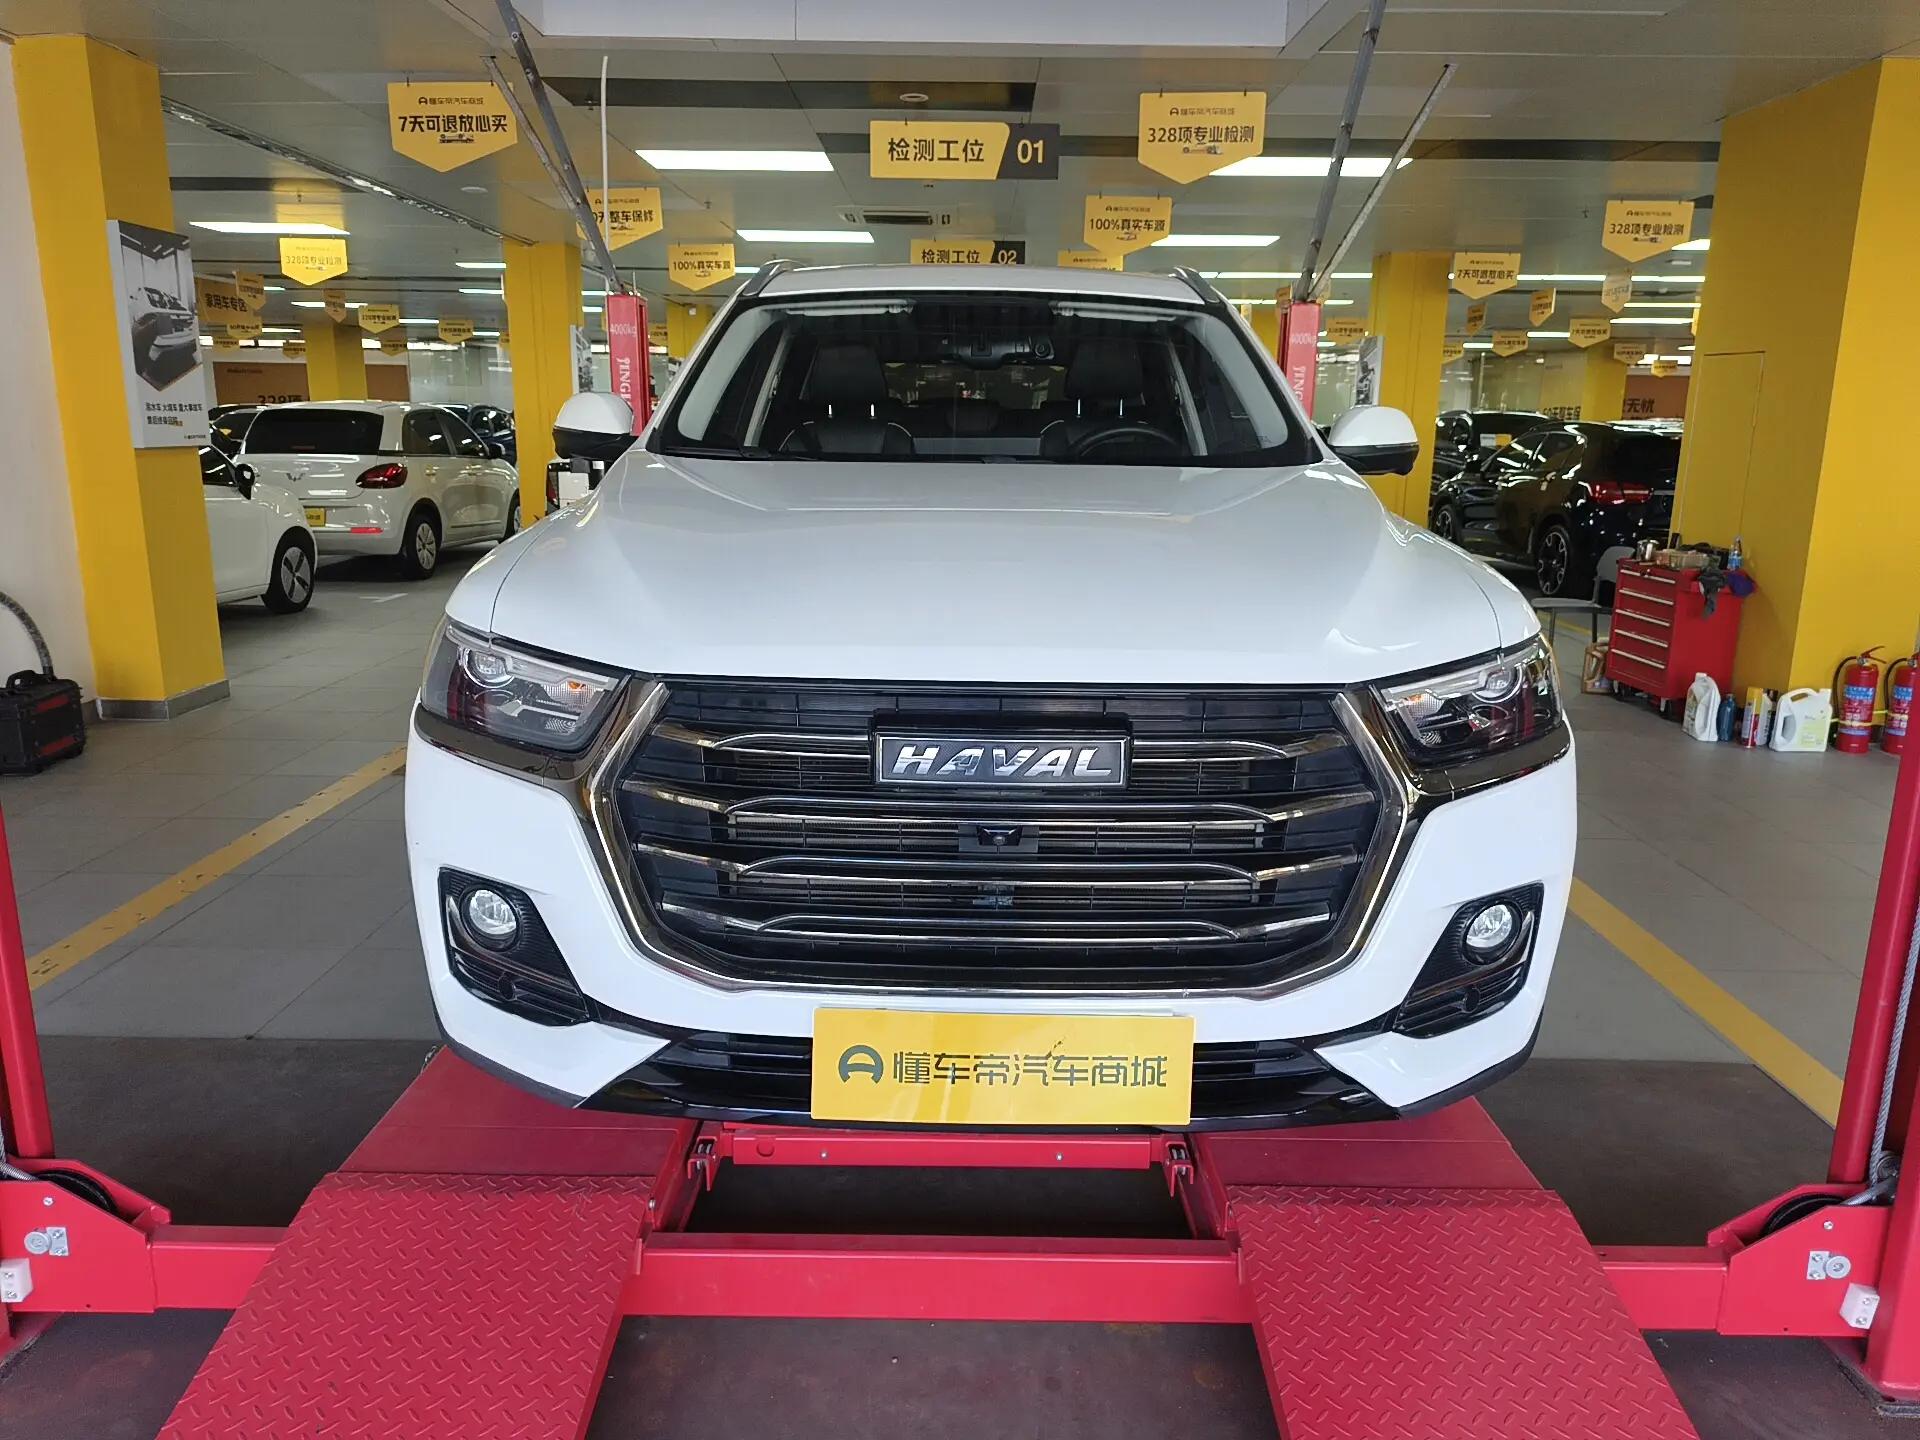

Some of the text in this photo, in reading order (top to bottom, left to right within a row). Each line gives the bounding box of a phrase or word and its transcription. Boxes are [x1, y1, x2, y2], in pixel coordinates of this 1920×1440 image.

[399, 114, 508, 132] 7天可退放心买
[1147, 126, 1255, 143] 328项专业检测
[888, 138, 1044, 164] 检测工位 01
[1089, 219, 1165, 231] 100%真实车源
[1609, 223, 1684, 236] 328项专业检测
[922, 250, 1017, 264] 检测工位 02
[610, 323, 637, 338] 4000kg
[891, 745, 1112, 777] HAVAL
[894, 1051, 1167, 1087] 懂车帝汽车商城
